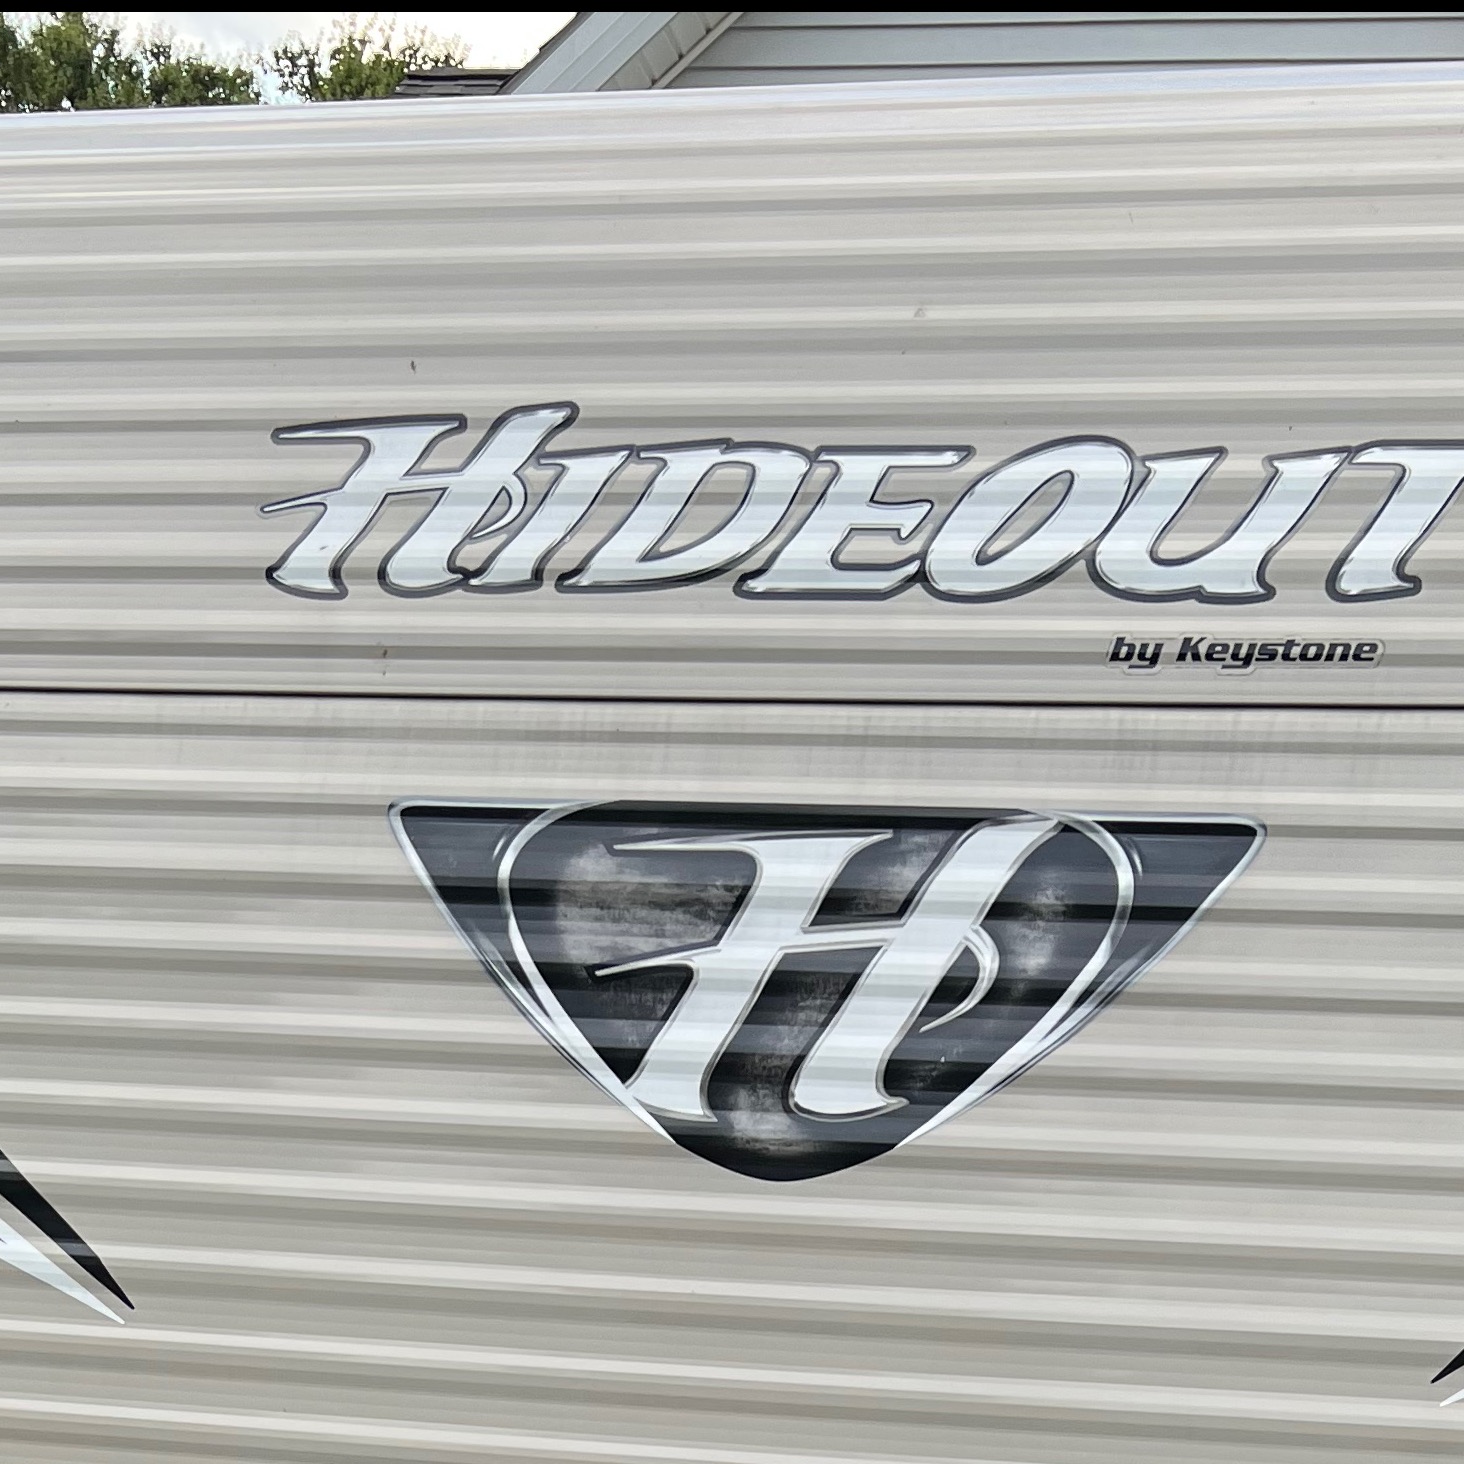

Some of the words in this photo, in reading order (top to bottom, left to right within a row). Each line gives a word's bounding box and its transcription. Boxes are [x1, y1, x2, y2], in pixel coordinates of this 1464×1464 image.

[1109, 637, 1164, 669] by
[1176, 637, 1379, 669] Keystone
[592, 818, 1066, 1122] H
